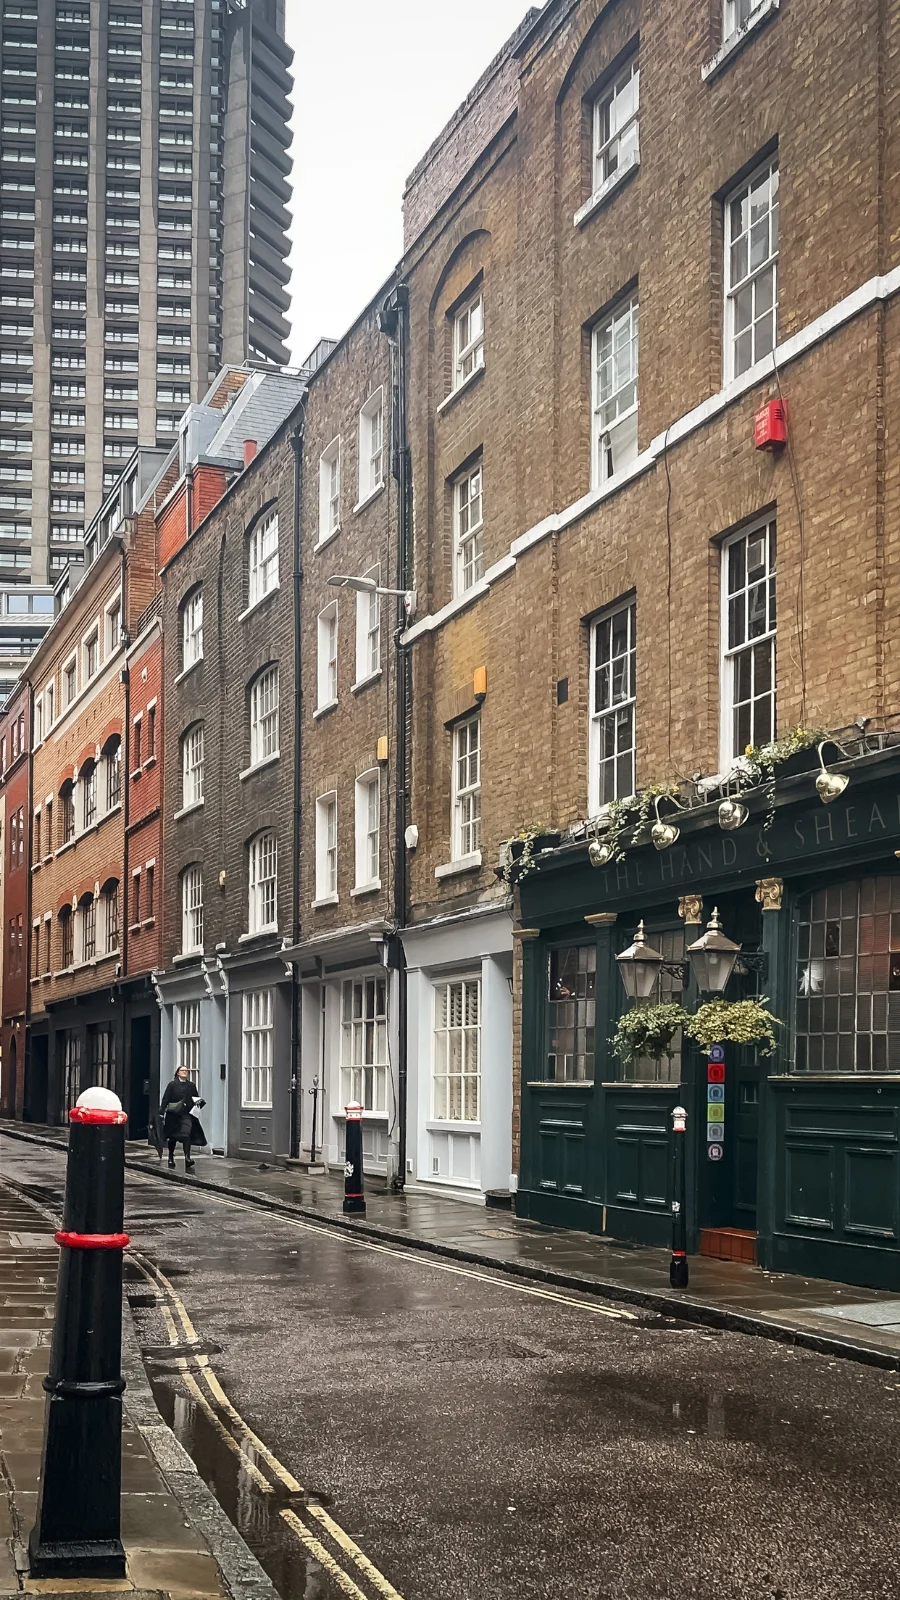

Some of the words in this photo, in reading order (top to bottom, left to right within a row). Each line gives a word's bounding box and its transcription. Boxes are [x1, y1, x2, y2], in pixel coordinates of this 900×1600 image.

[601, 862, 645, 893] THE
[660, 838, 737, 881] HAND
[756, 825, 774, 857] &
[794, 794, 900, 849] SHEA
